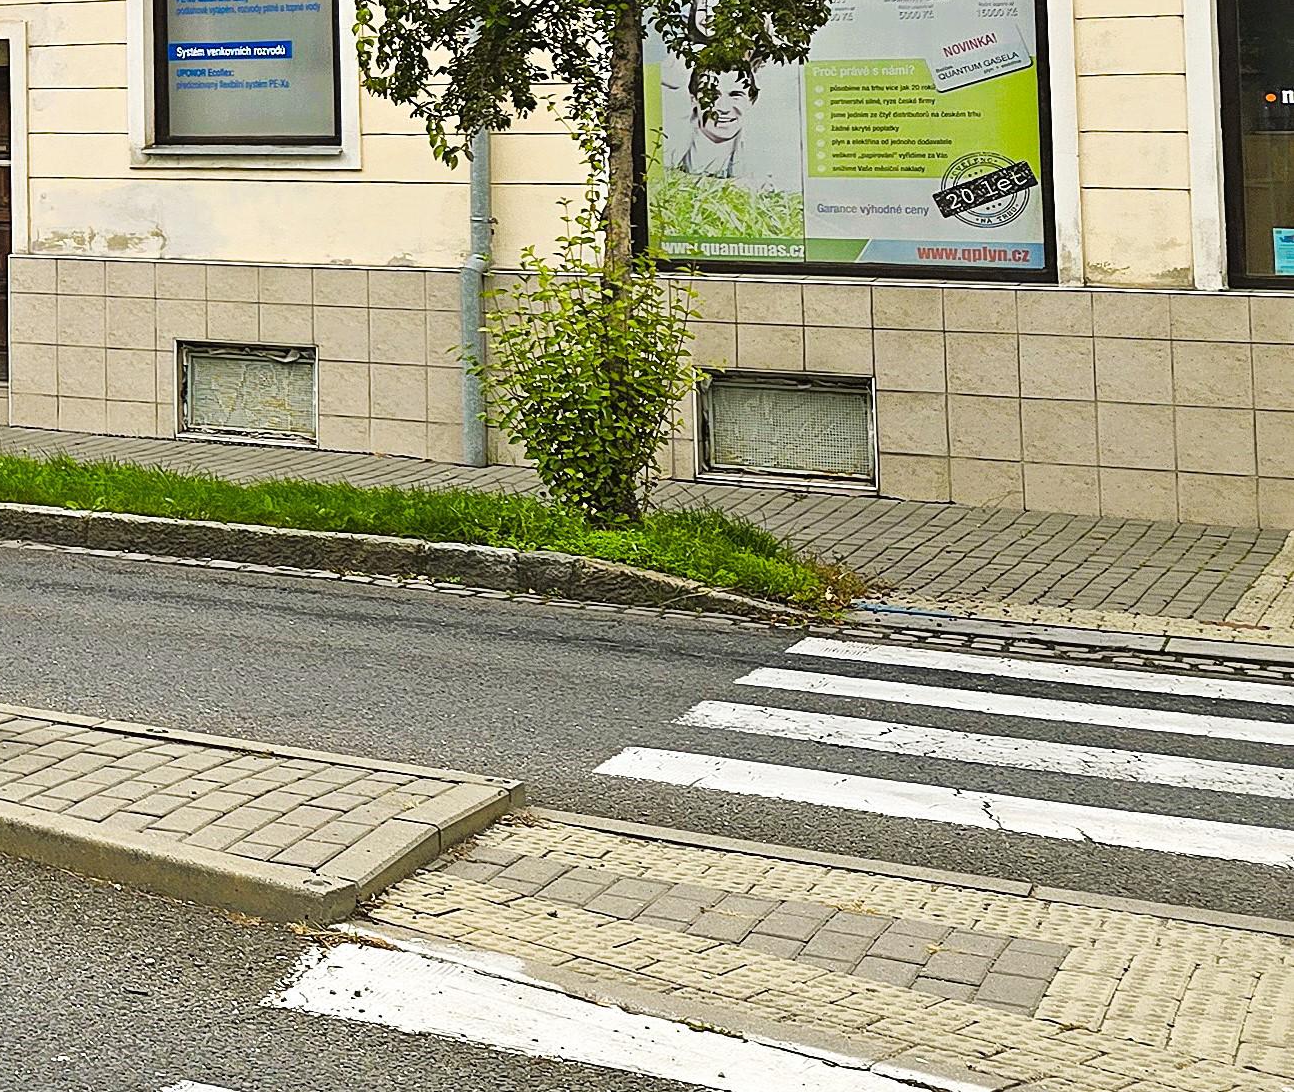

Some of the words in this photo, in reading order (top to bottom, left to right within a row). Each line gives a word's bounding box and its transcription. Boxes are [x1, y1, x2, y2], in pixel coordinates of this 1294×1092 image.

[176, 46, 205, 59] Systém
[206, 46, 252, 57] venkovních
[253, 44, 286, 56] rozvodů
[942, 32, 998, 58] NOVINKA!
[812, 66, 838, 77] Proč
[938, 61, 983, 81] QUANTUM
[982, 51, 1020, 68] GASELA
[911, 84, 920, 92] 20
[945, 187, 975, 210] 20
[980, 171, 1028, 198] let
[817, 203, 858, 215] Garance
[859, 203, 902, 217] výhodné
[904, 205, 930, 219] ceny
[661, 240, 805, 258] wwwquantumas.cz
[916, 246, 1031, 264] www.qplyn.cz
